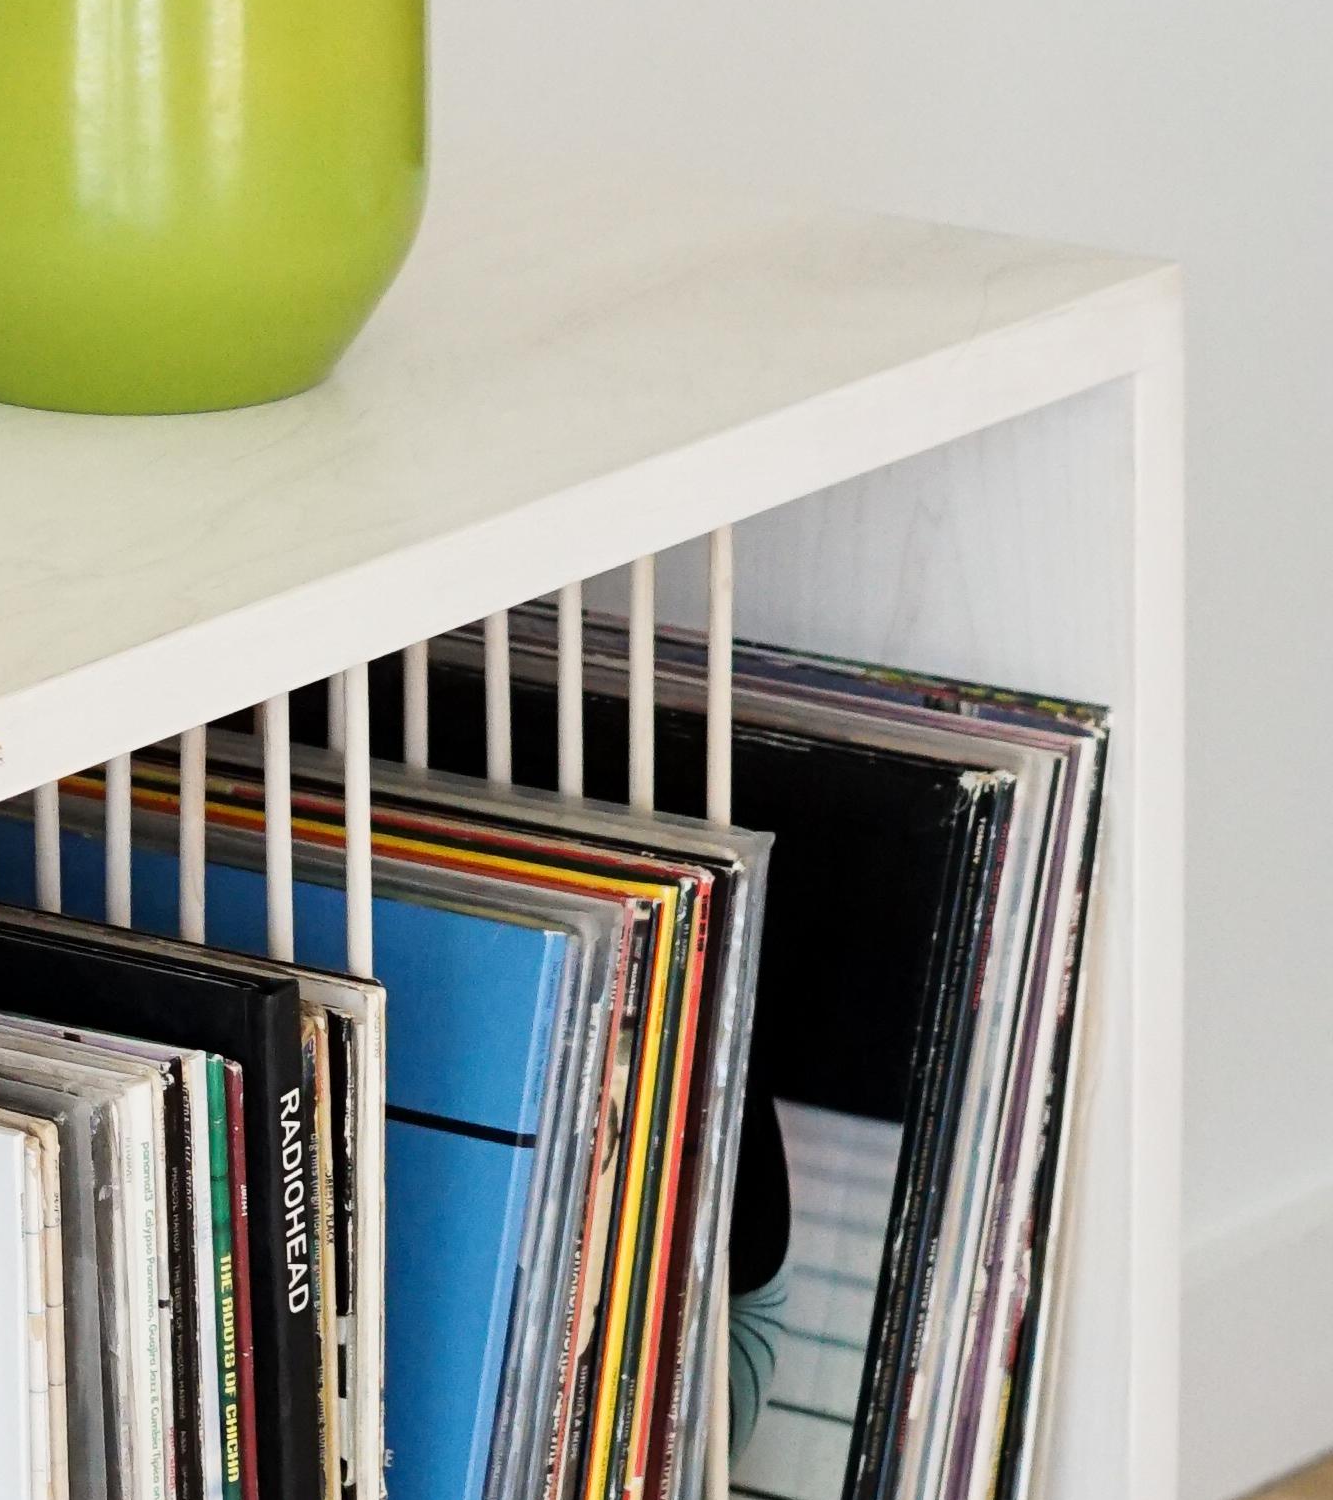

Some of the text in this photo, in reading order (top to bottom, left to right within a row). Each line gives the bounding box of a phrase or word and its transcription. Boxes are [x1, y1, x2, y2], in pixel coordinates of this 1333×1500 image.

[971, 816, 988, 865] TOMMY
[169, 1166, 181, 1212] PROCOL
[278, 1086, 310, 1315] RADIOHEAD
[142, 1208, 156, 1256] Calypso
[171, 1213, 182, 1254] HARUM
[172, 1263, 183, 1286] THE
[218, 1252, 233, 1295] THE
[173, 1286, 184, 1315] BEST
[146, 1323, 160, 1367] Guajira
[174, 1316, 185, 1331] OF
[220, 1296, 236, 1370] ROOTS
[147, 1368, 160, 1395] Jazz
[148, 1395, 161, 1404] &
[222, 1372, 237, 1399] OF
[148, 1406, 162, 1451] Cumbia
[225, 1403, 240, 1484] CHICHA
